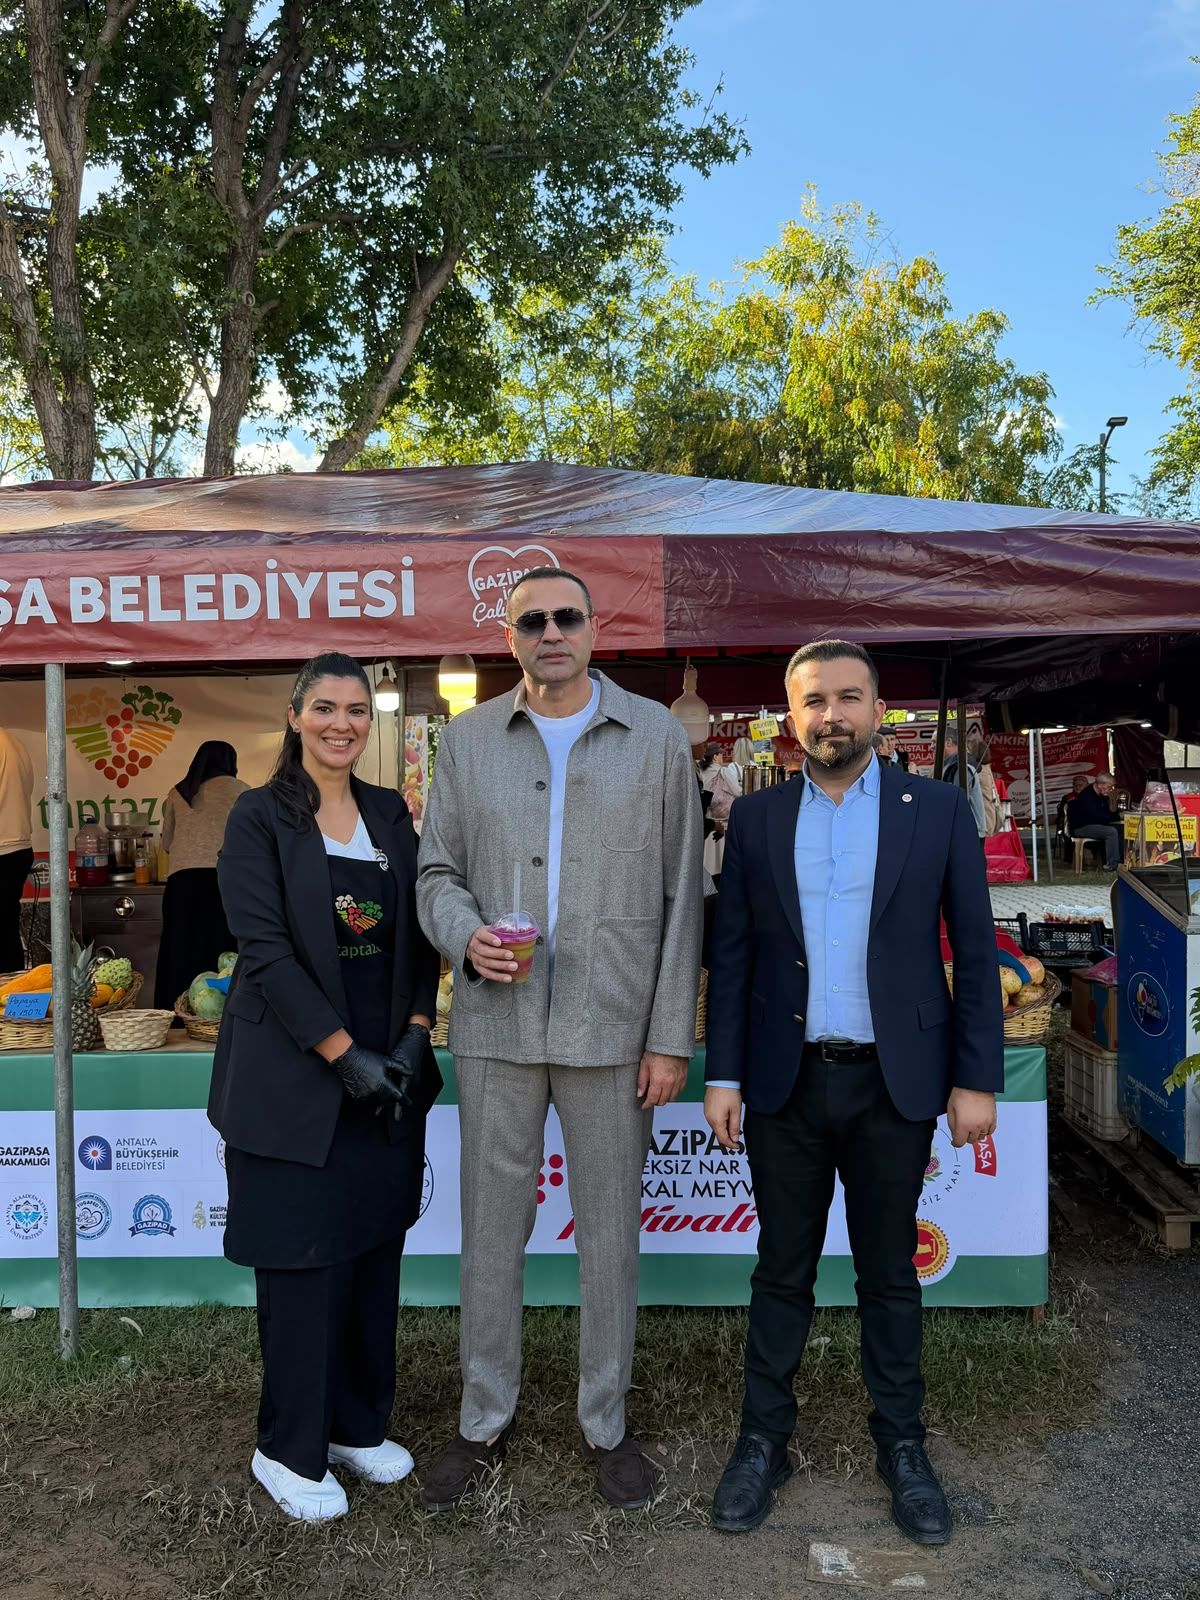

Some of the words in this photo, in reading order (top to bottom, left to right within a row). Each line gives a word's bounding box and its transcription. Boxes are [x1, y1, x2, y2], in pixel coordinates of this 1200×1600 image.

[69, 555, 416, 624] BELEDİYESİ
[472, 598, 507, 628] Çalı
[37, 795, 169, 831] tptaz
[1155, 820, 1194, 830] Osmnlı
[338, 944, 382, 959] aptaz
[115, 1137, 158, 1147] ANTALYA
[115, 1147, 179, 1160] BÜYÜKŞEHİR
[116, 1159, 166, 1171] BELEDİYESİ
[642, 1159, 693, 1175] EKSİZ
[698, 1159, 741, 1175] NAR
[640, 1180, 684, 1198] KAL
[691, 1180, 754, 1198] MEYV
[209, 1205, 227, 1213] GAZİPA
[209, 1212, 226, 1220] KÜLTÜ
